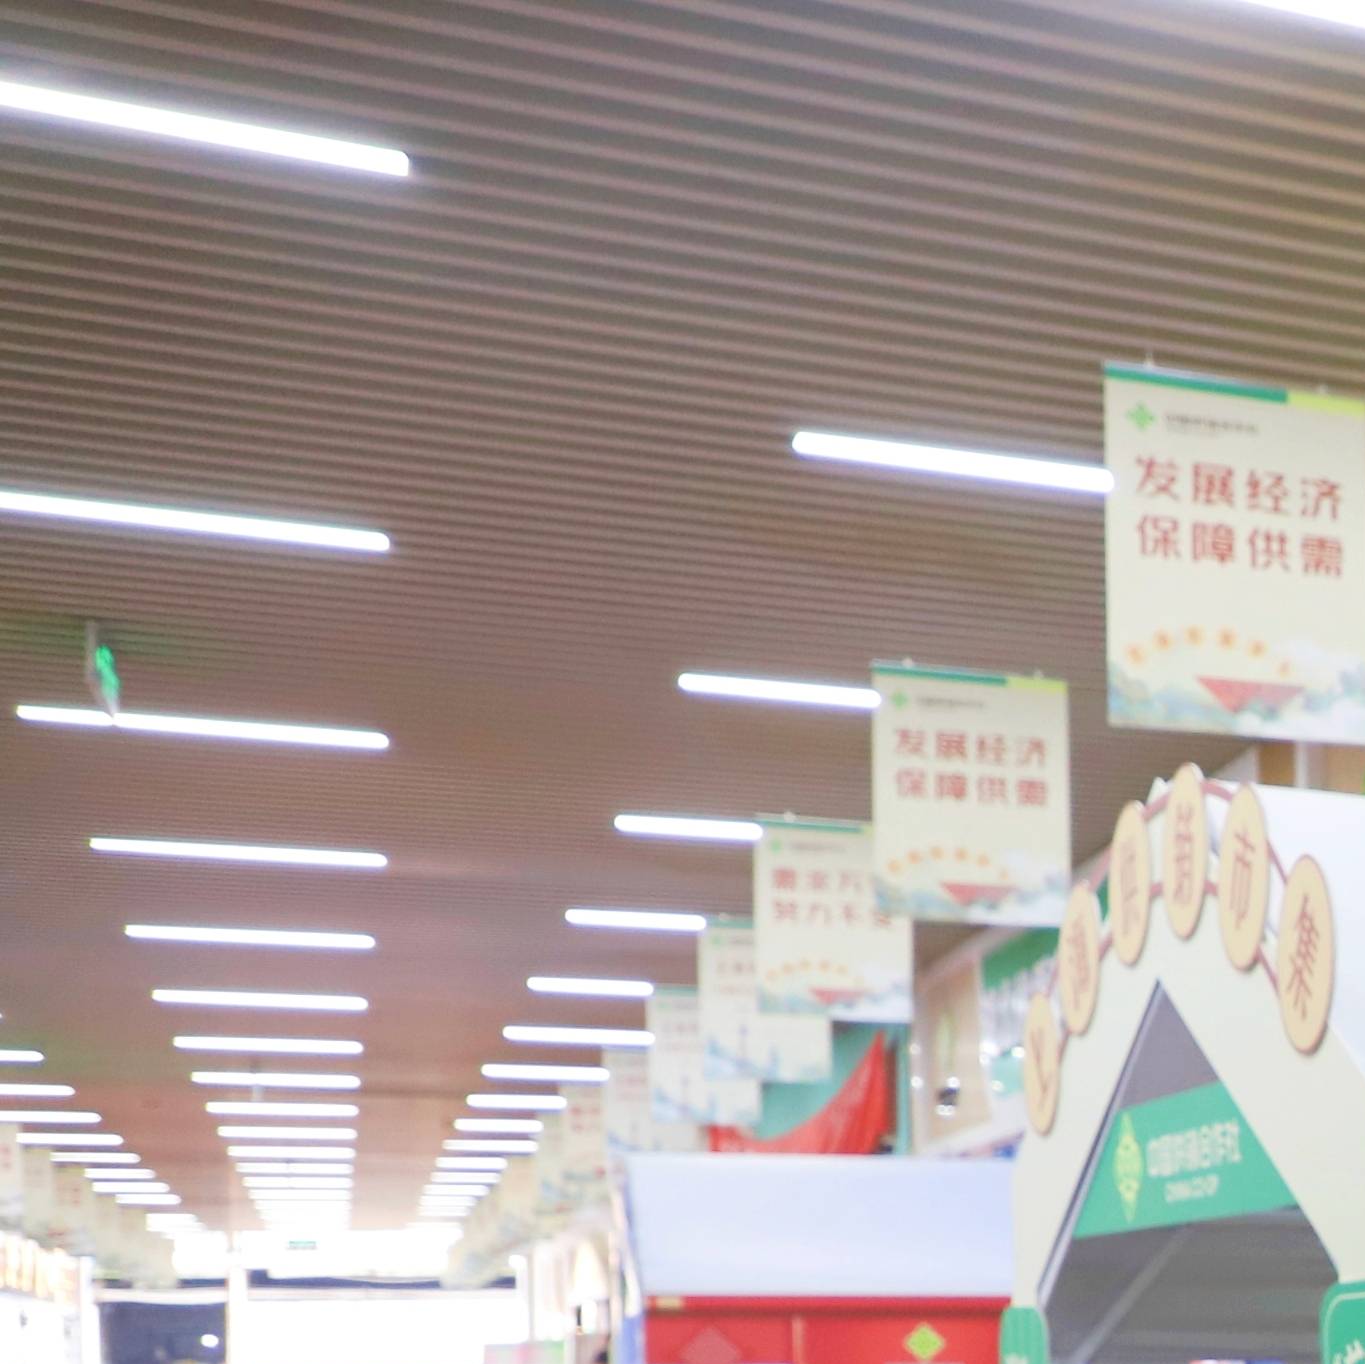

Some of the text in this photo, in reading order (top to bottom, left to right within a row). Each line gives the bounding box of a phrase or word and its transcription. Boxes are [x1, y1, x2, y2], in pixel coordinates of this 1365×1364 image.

[1134, 453, 1343, 521] 发展经济
[1135, 513, 1344, 578] 保障供需
